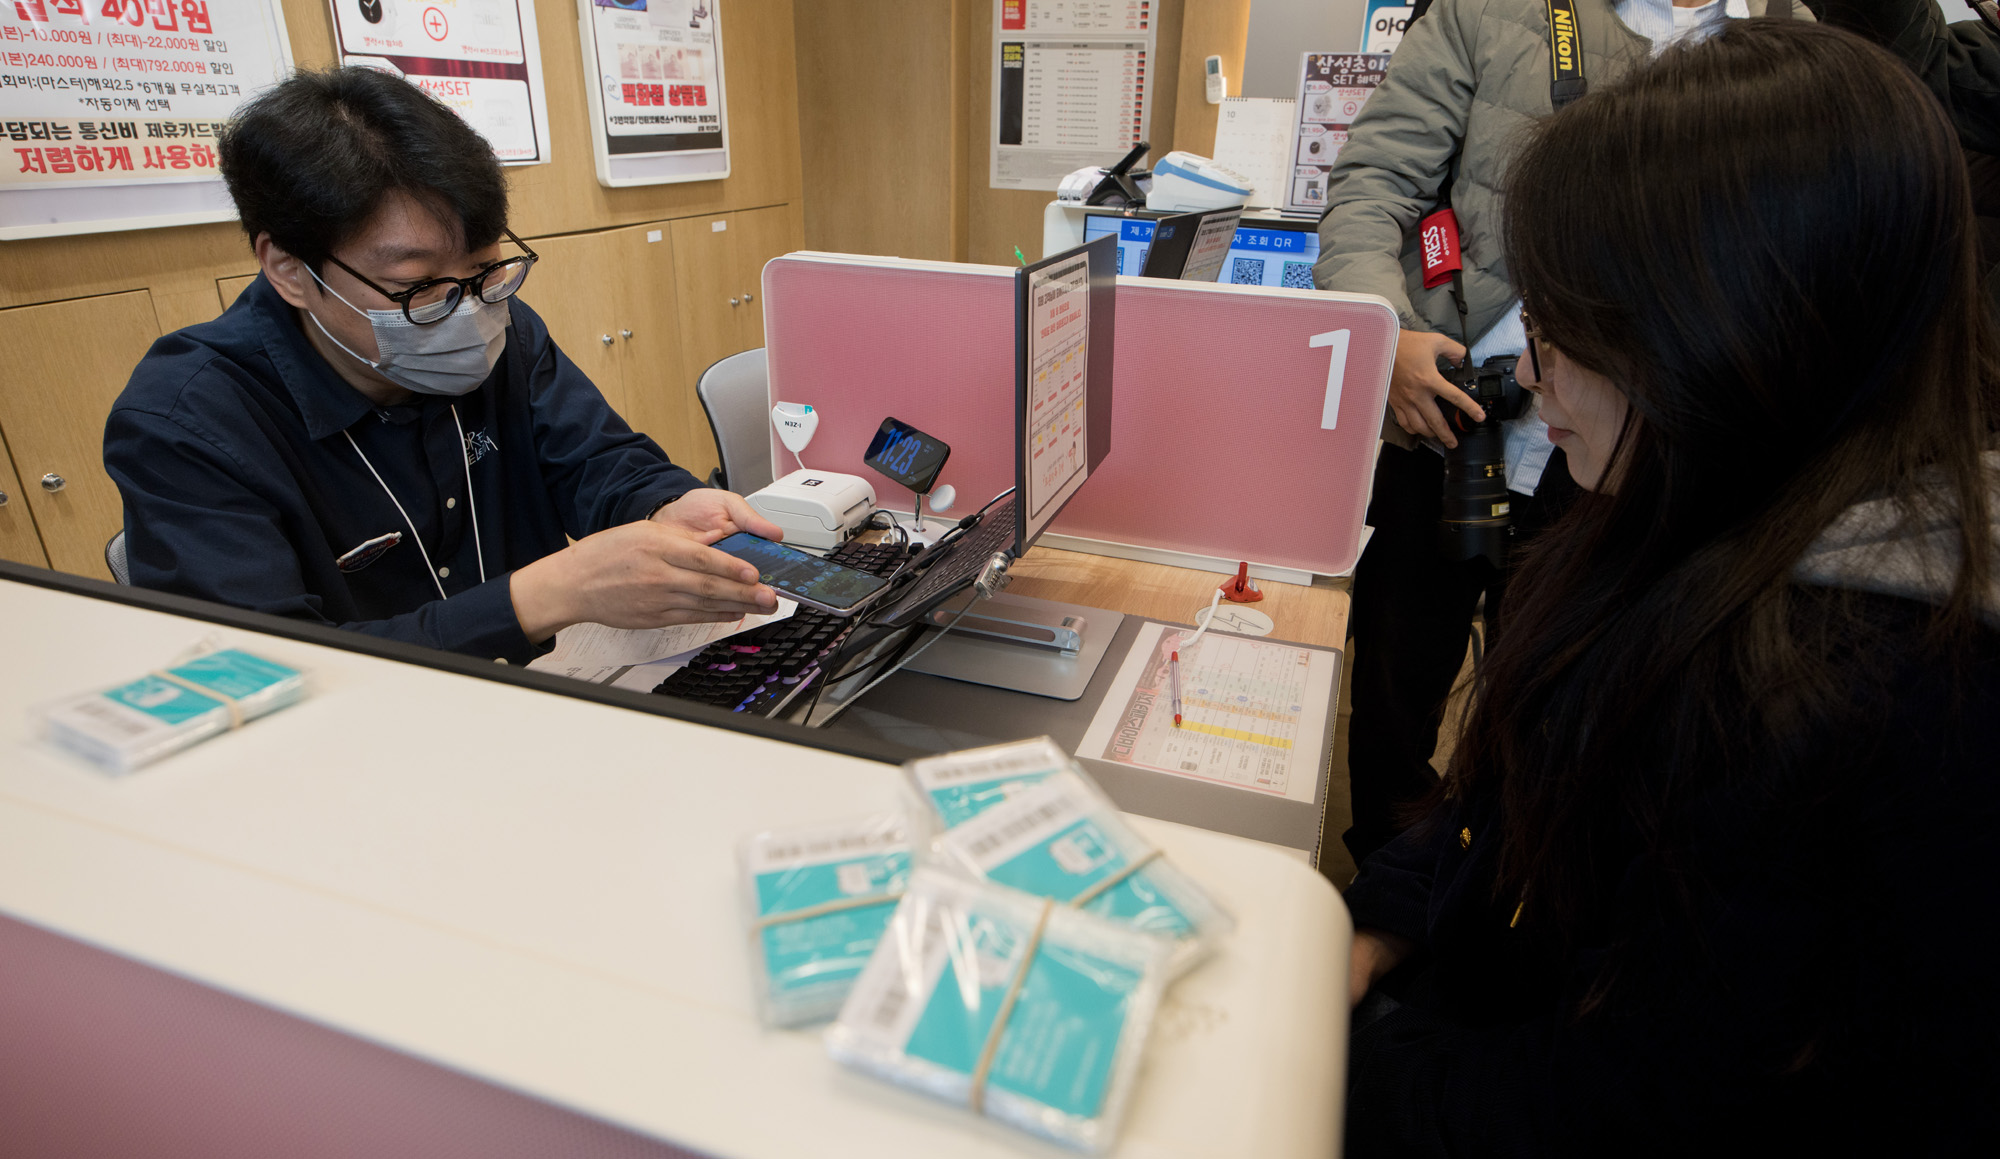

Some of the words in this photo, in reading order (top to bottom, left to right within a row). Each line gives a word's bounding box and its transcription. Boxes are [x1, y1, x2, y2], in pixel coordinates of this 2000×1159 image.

[0, 26, 92, 45] 본)-10.000원
[204, 39, 228, 52] 할인
[1553, 9, 1573, 71] Nikon
[112, 57, 206, 74] (최대)792.000원
[210, 62, 234, 75] 할인
[1317, 55, 1389, 74] 삼성초이
[0, 75, 134, 93] 회비:(마스터)해외2.5
[181, 82, 241, 97] 무실적고객
[1333, 74, 1354, 84] SET
[1357, 74, 1381, 85] 혜택
[146, 98, 171, 112] 선택
[621, 83, 665, 106] 백화점
[669, 84, 708, 106] 상품권
[1226, 110, 1236, 119] 10
[78, 121, 139, 140] 통신비
[14, 145, 134, 174] 저렴하게
[143, 143, 221, 170] 사용하
[1248, 234, 1269, 246] 조회
[1274, 237, 1293, 249] QR
[1422, 225, 1443, 269] PRESS
[1309, 328, 1351, 430] 1
[876, 428, 922, 475] 11:23
